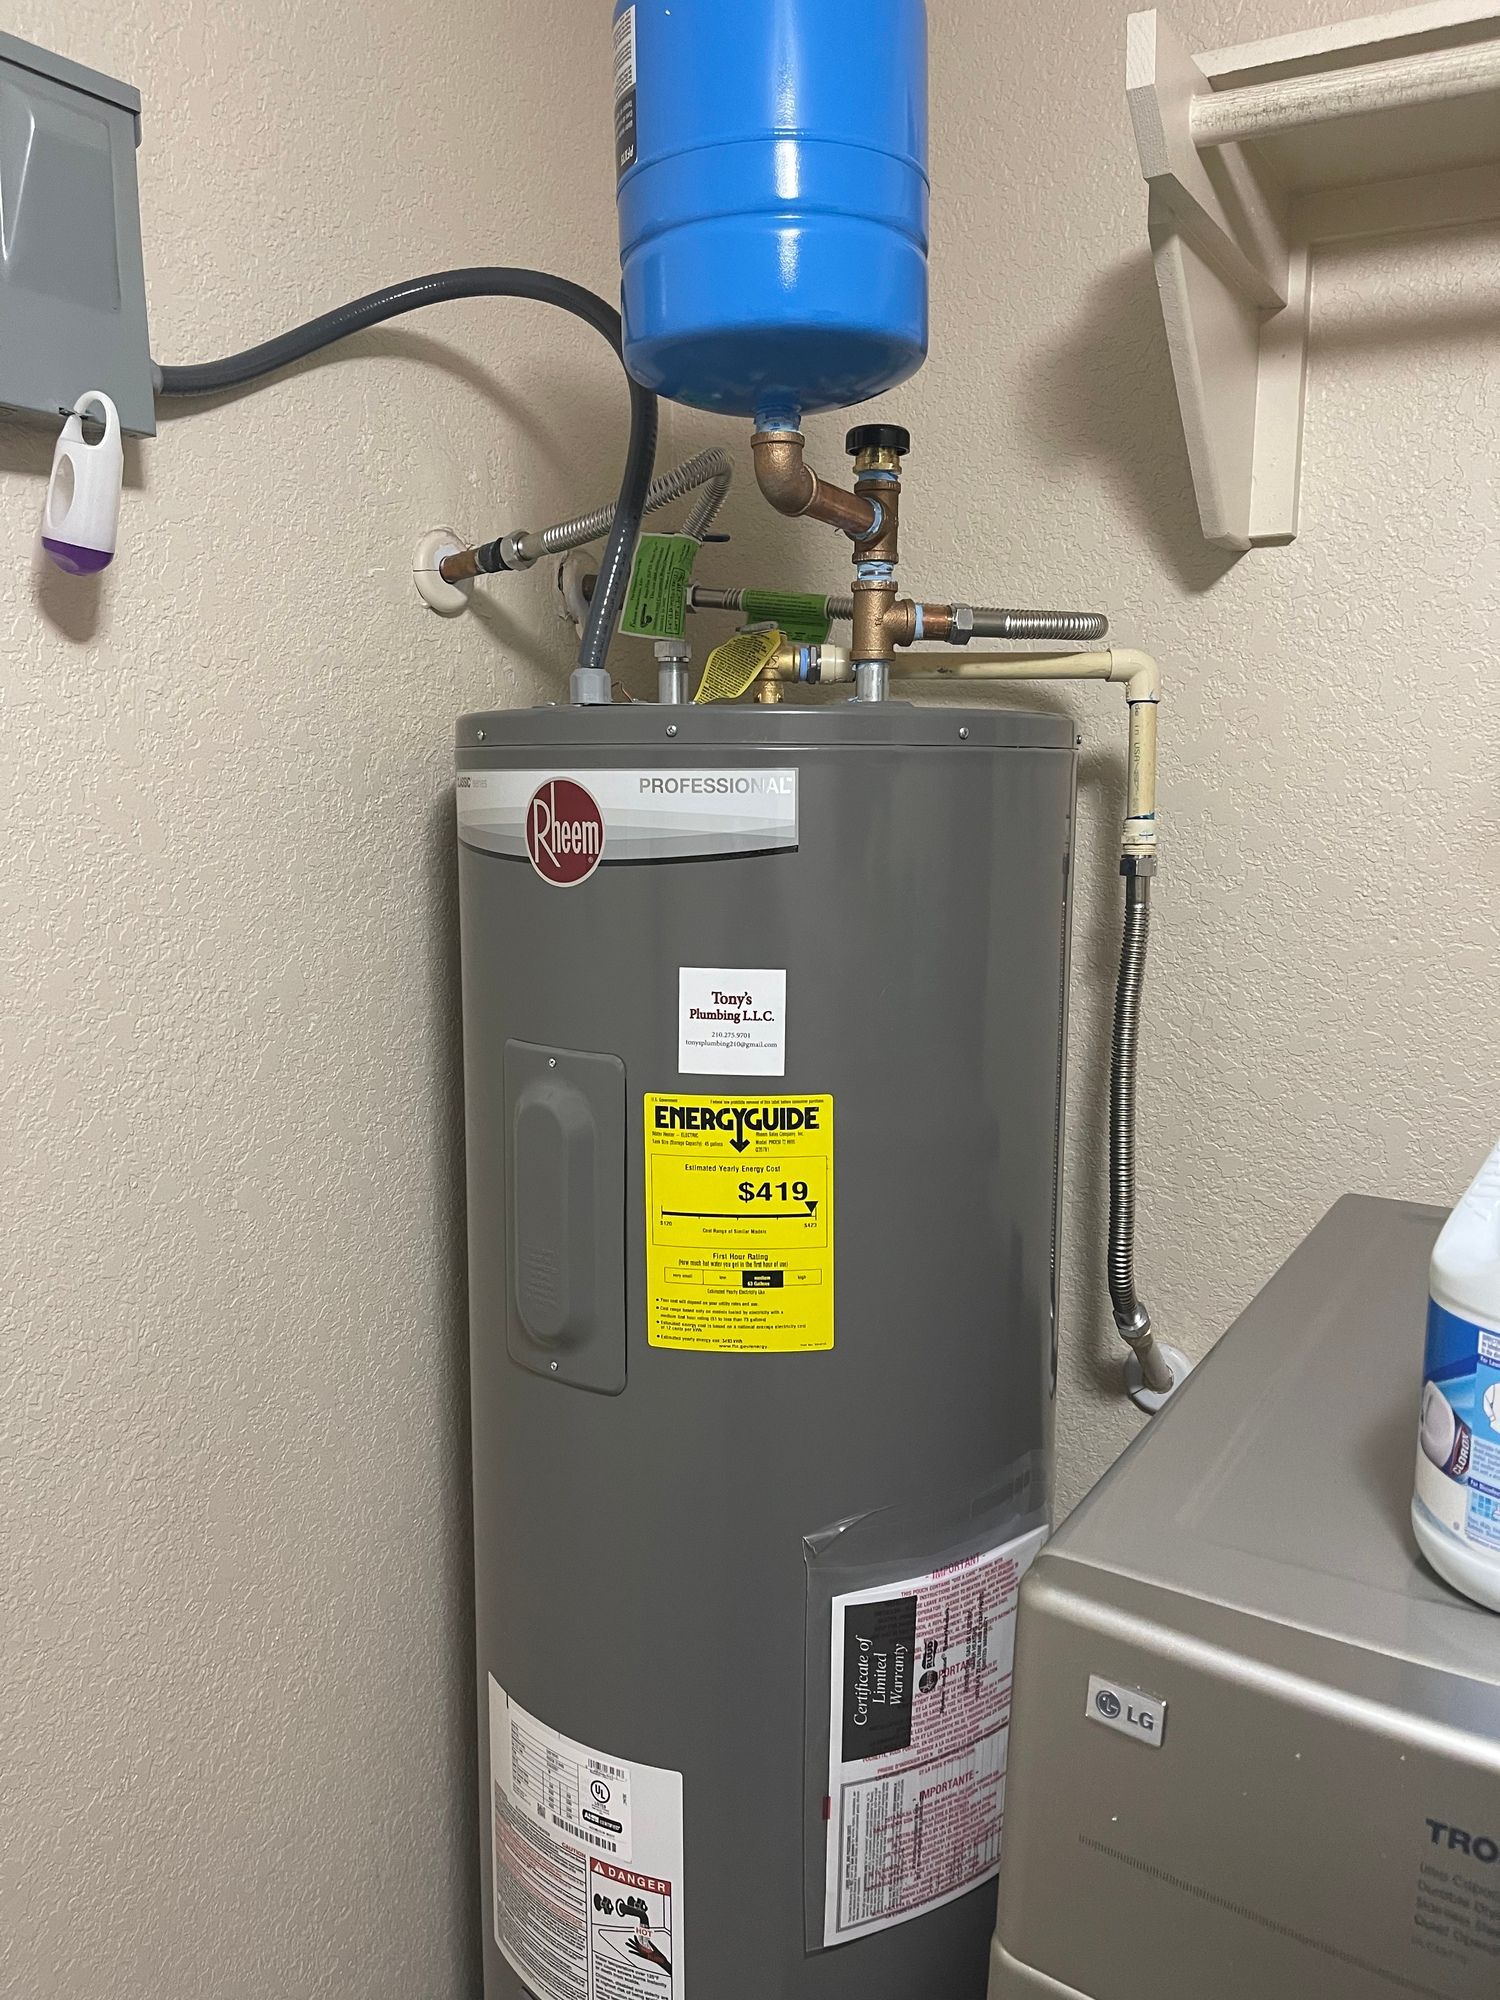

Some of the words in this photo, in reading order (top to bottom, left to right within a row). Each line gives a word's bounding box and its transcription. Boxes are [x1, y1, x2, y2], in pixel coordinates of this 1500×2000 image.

[640, 776, 790, 795] PROFESSIONAL
[534, 782, 600, 868] Rheem
[712, 992, 752, 1009] Tony's
[690, 1008, 740, 1024] Plumbing
[743, 1010, 774, 1022] L.L.C.
[686, 1040, 778, 1048] tonysplumbing210@gmail.com
[655, 1106, 819, 1132] ENERGYGUIDE
[685, 1164, 716, 1172] Estimated
[719, 1165, 739, 1173] Yearly
[742, 1166, 764, 1174] Energy
[738, 1181, 808, 1203] $419
[1453, 1434, 1470, 1475] CLOROX
[932, 1552, 980, 1580] IMPORTANT
[855, 1635, 873, 1651] of
[872, 1652, 888, 1704] Limited
[890, 1643, 908, 1705] Warranty
[853, 1655, 871, 1726] Certificate
[1127, 1704, 1155, 1732] LG
[919, 1770, 974, 1800] IMPORTANTE
[561, 1842, 586, 1858] CAUTION
[608, 1866, 666, 1893] DANGER
[636, 1926, 653, 1937] HOT
